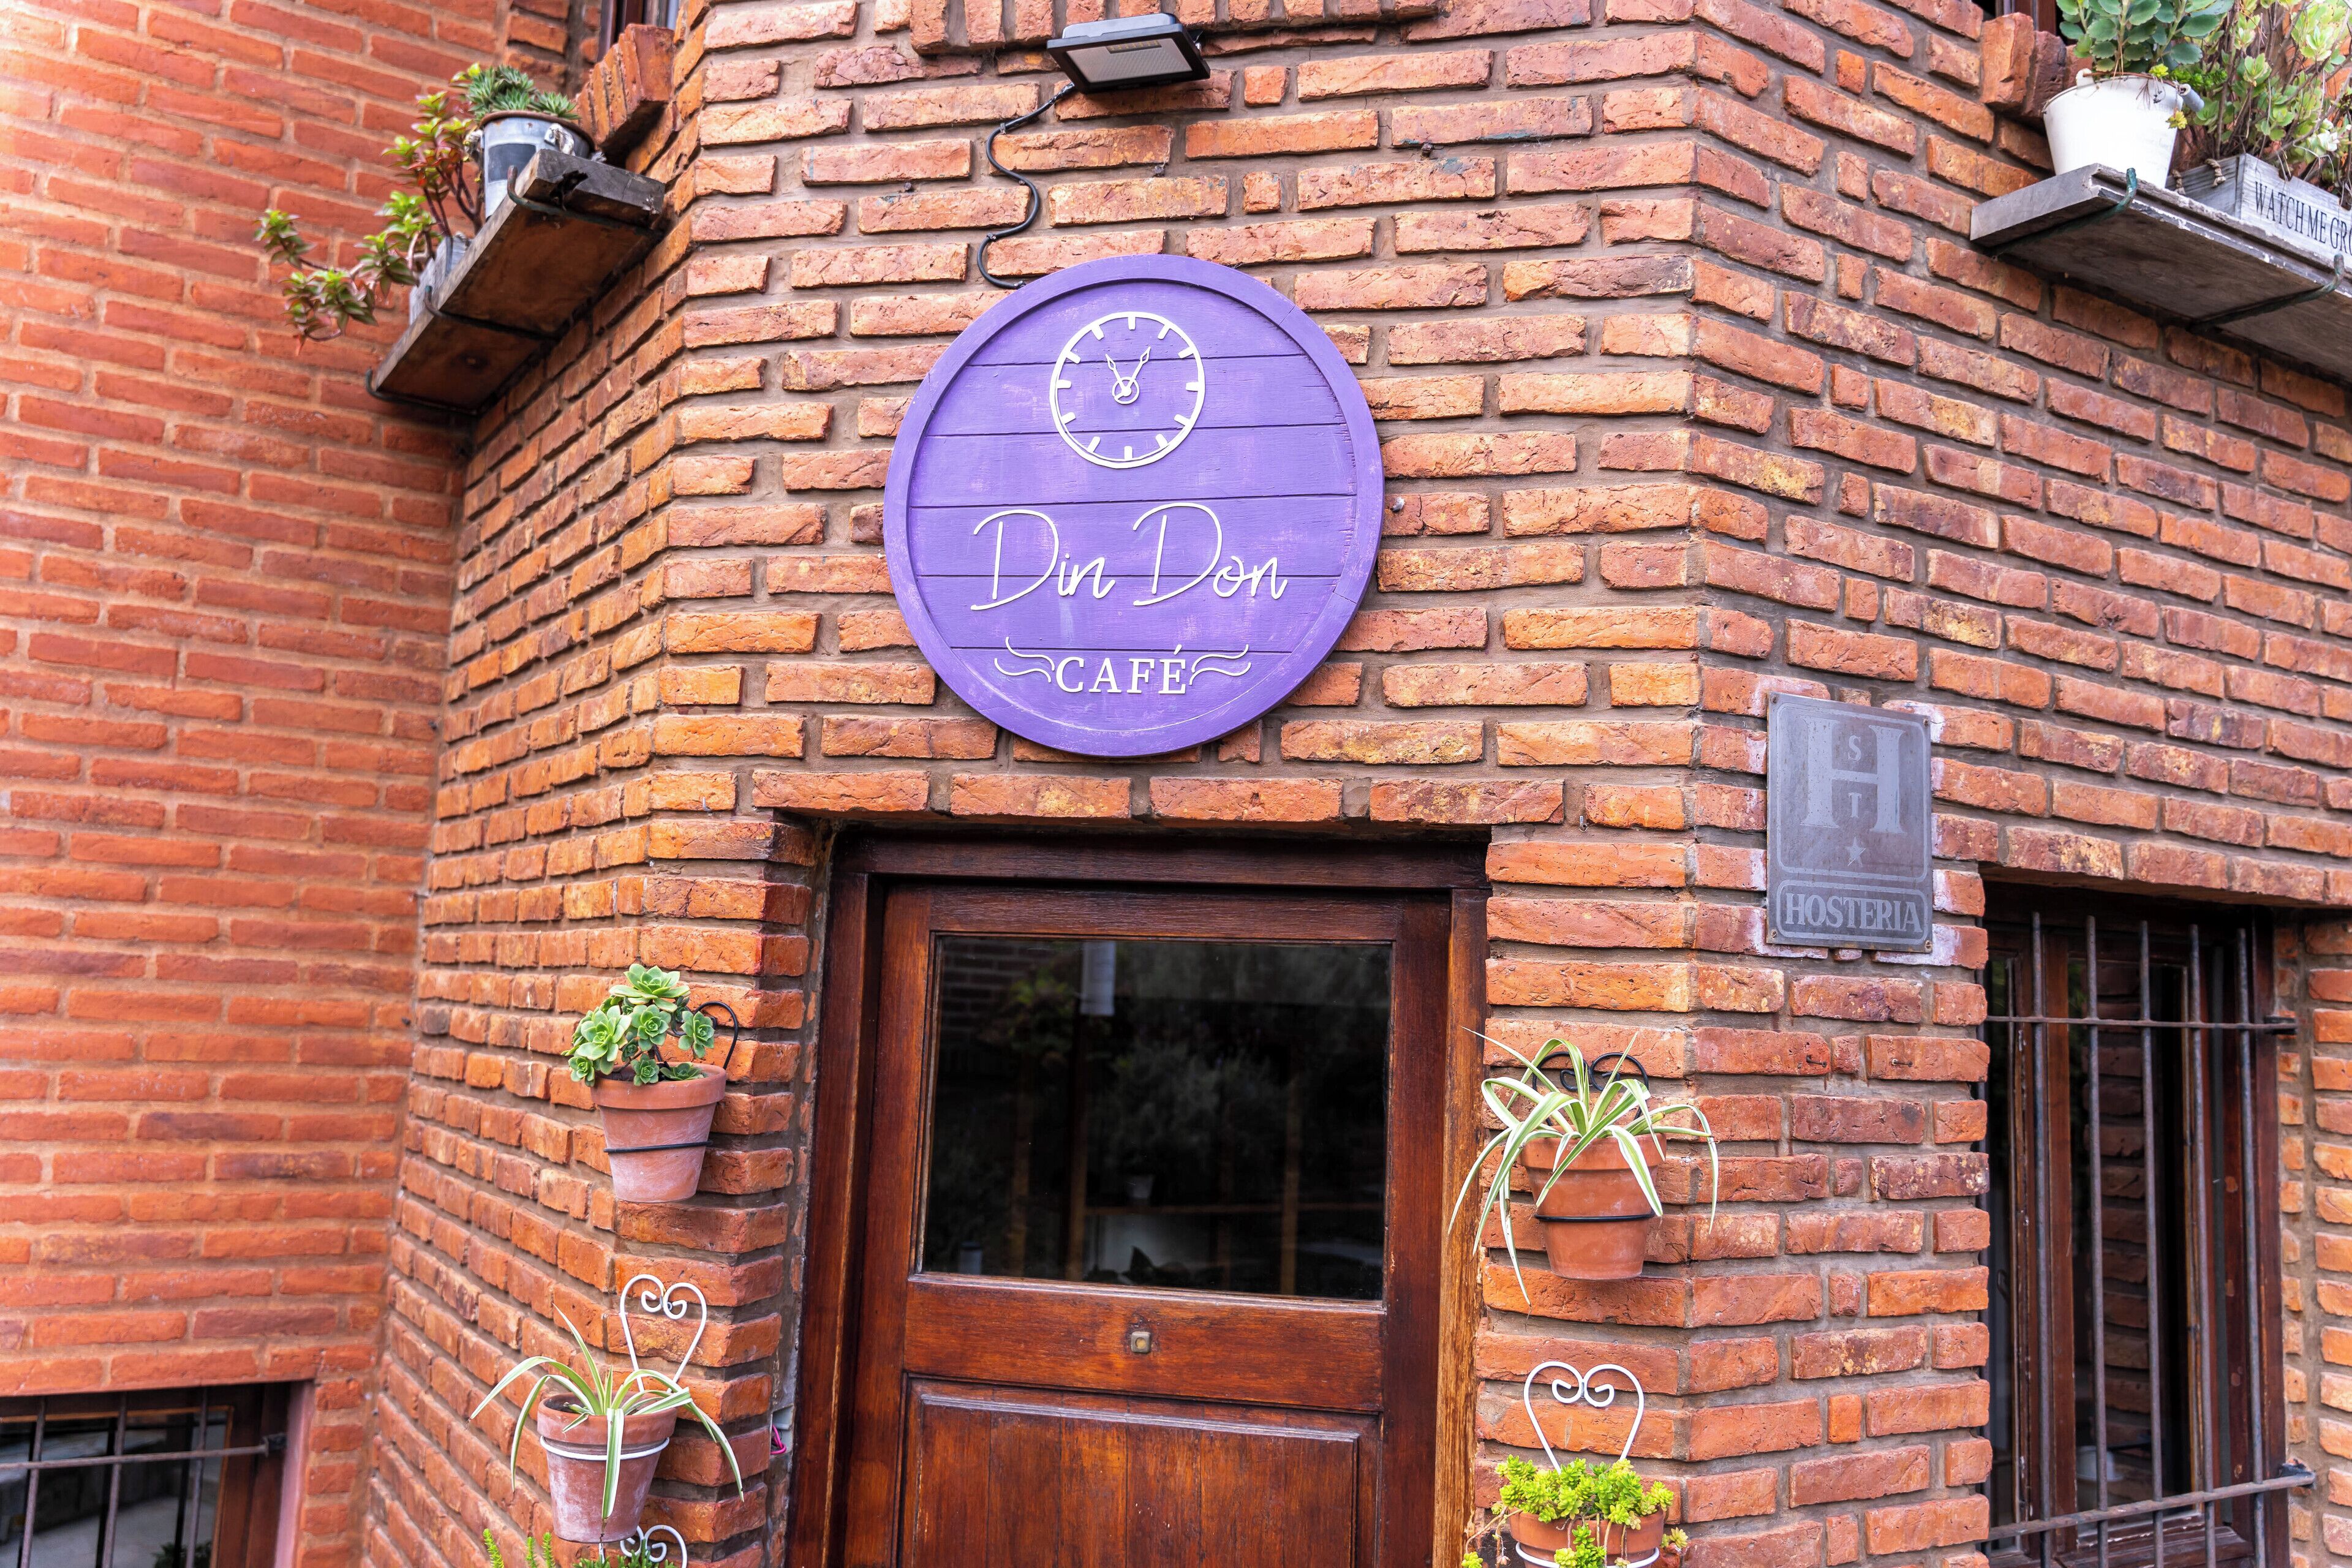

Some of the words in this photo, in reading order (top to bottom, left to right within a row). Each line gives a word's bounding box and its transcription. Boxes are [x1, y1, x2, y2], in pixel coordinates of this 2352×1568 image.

[2255, 181, 2305, 234] WATCH
[2307, 205, 2327, 244] ME
[971, 510, 1116, 611] Din
[1133, 502, 1287, 606] Don
[1056, 644, 1186, 695] CAFÉ
[1800, 715, 1907, 834] H
[1785, 892, 1921, 933] HOSTERIA
